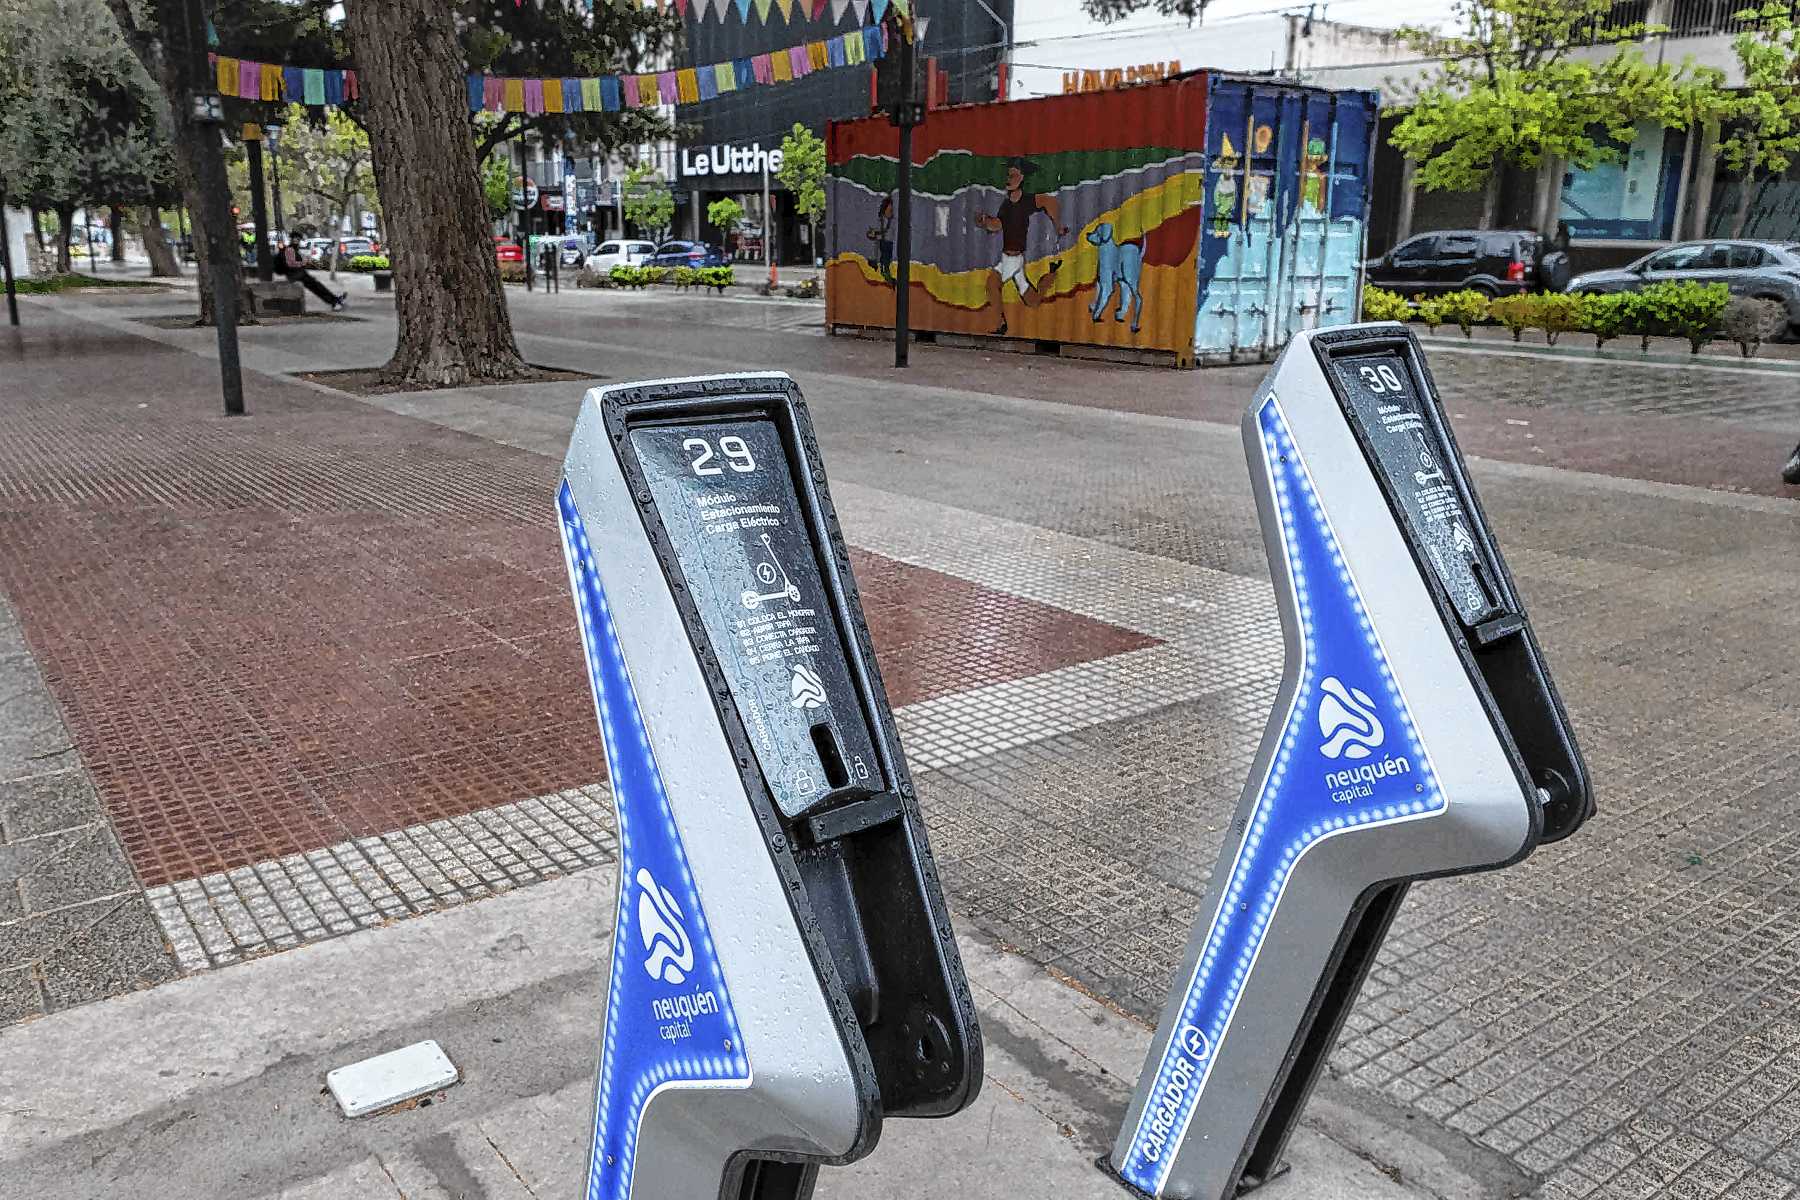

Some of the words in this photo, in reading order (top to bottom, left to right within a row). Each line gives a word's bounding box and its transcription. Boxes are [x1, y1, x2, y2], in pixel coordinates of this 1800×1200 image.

[1360, 365, 1402, 393] 30
[683, 436, 755, 476] 29
[696, 493, 736, 508] Módulo
[701, 503, 780, 521] Estacionamiento
[706, 521, 740, 535] Carga
[740, 516, 779, 528] Eléctrico
[1325, 753, 1410, 789] neuquén
[1332, 783, 1373, 804] capital
[652, 984, 719, 1023] neuquén
[660, 1020, 691, 1045] capital
[1142, 1057, 1195, 1162] CARGADOR
